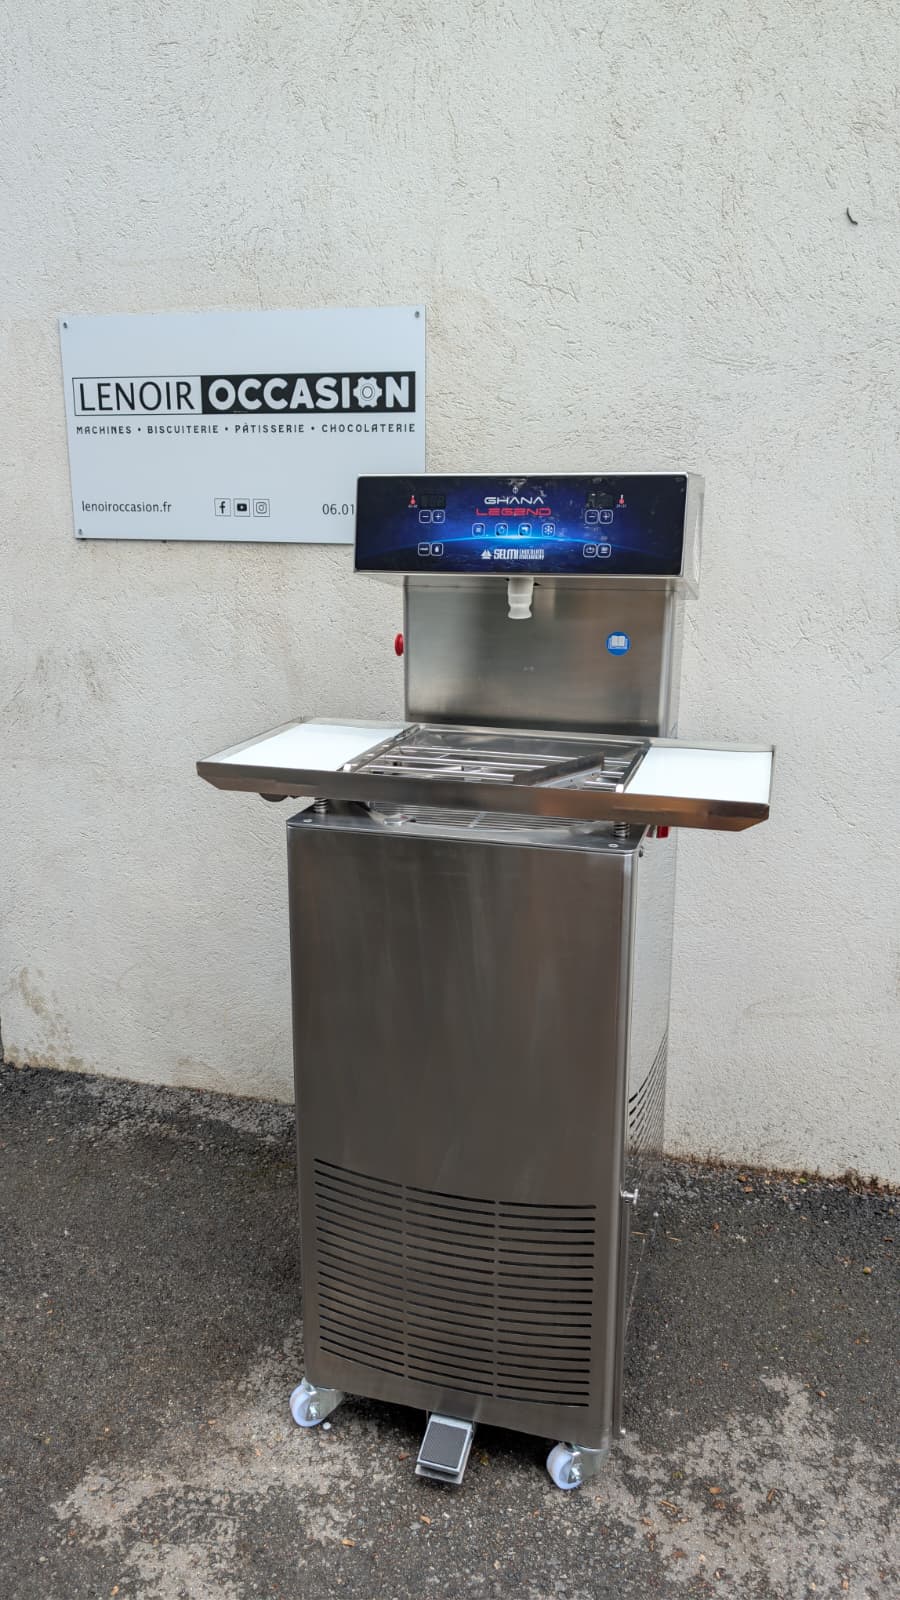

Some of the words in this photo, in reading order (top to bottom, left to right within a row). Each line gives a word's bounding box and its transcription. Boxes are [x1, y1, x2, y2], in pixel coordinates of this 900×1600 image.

[79, 381, 195, 411] LENOIR
[76, 425, 132, 434] MACHINES
[147, 425, 219, 434] BISCUITERIE
[235, 422, 305, 433] PÂTISSERIE
[321, 423, 415, 433] CHOCOLATERIE
[484, 496, 544, 505] GHANA
[81, 501, 172, 513] lenoiroccasion.fr
[322, 503, 355, 515] 06.01
[475, 507, 552, 517] LEGEND
[493, 548, 519, 560] SELMI
